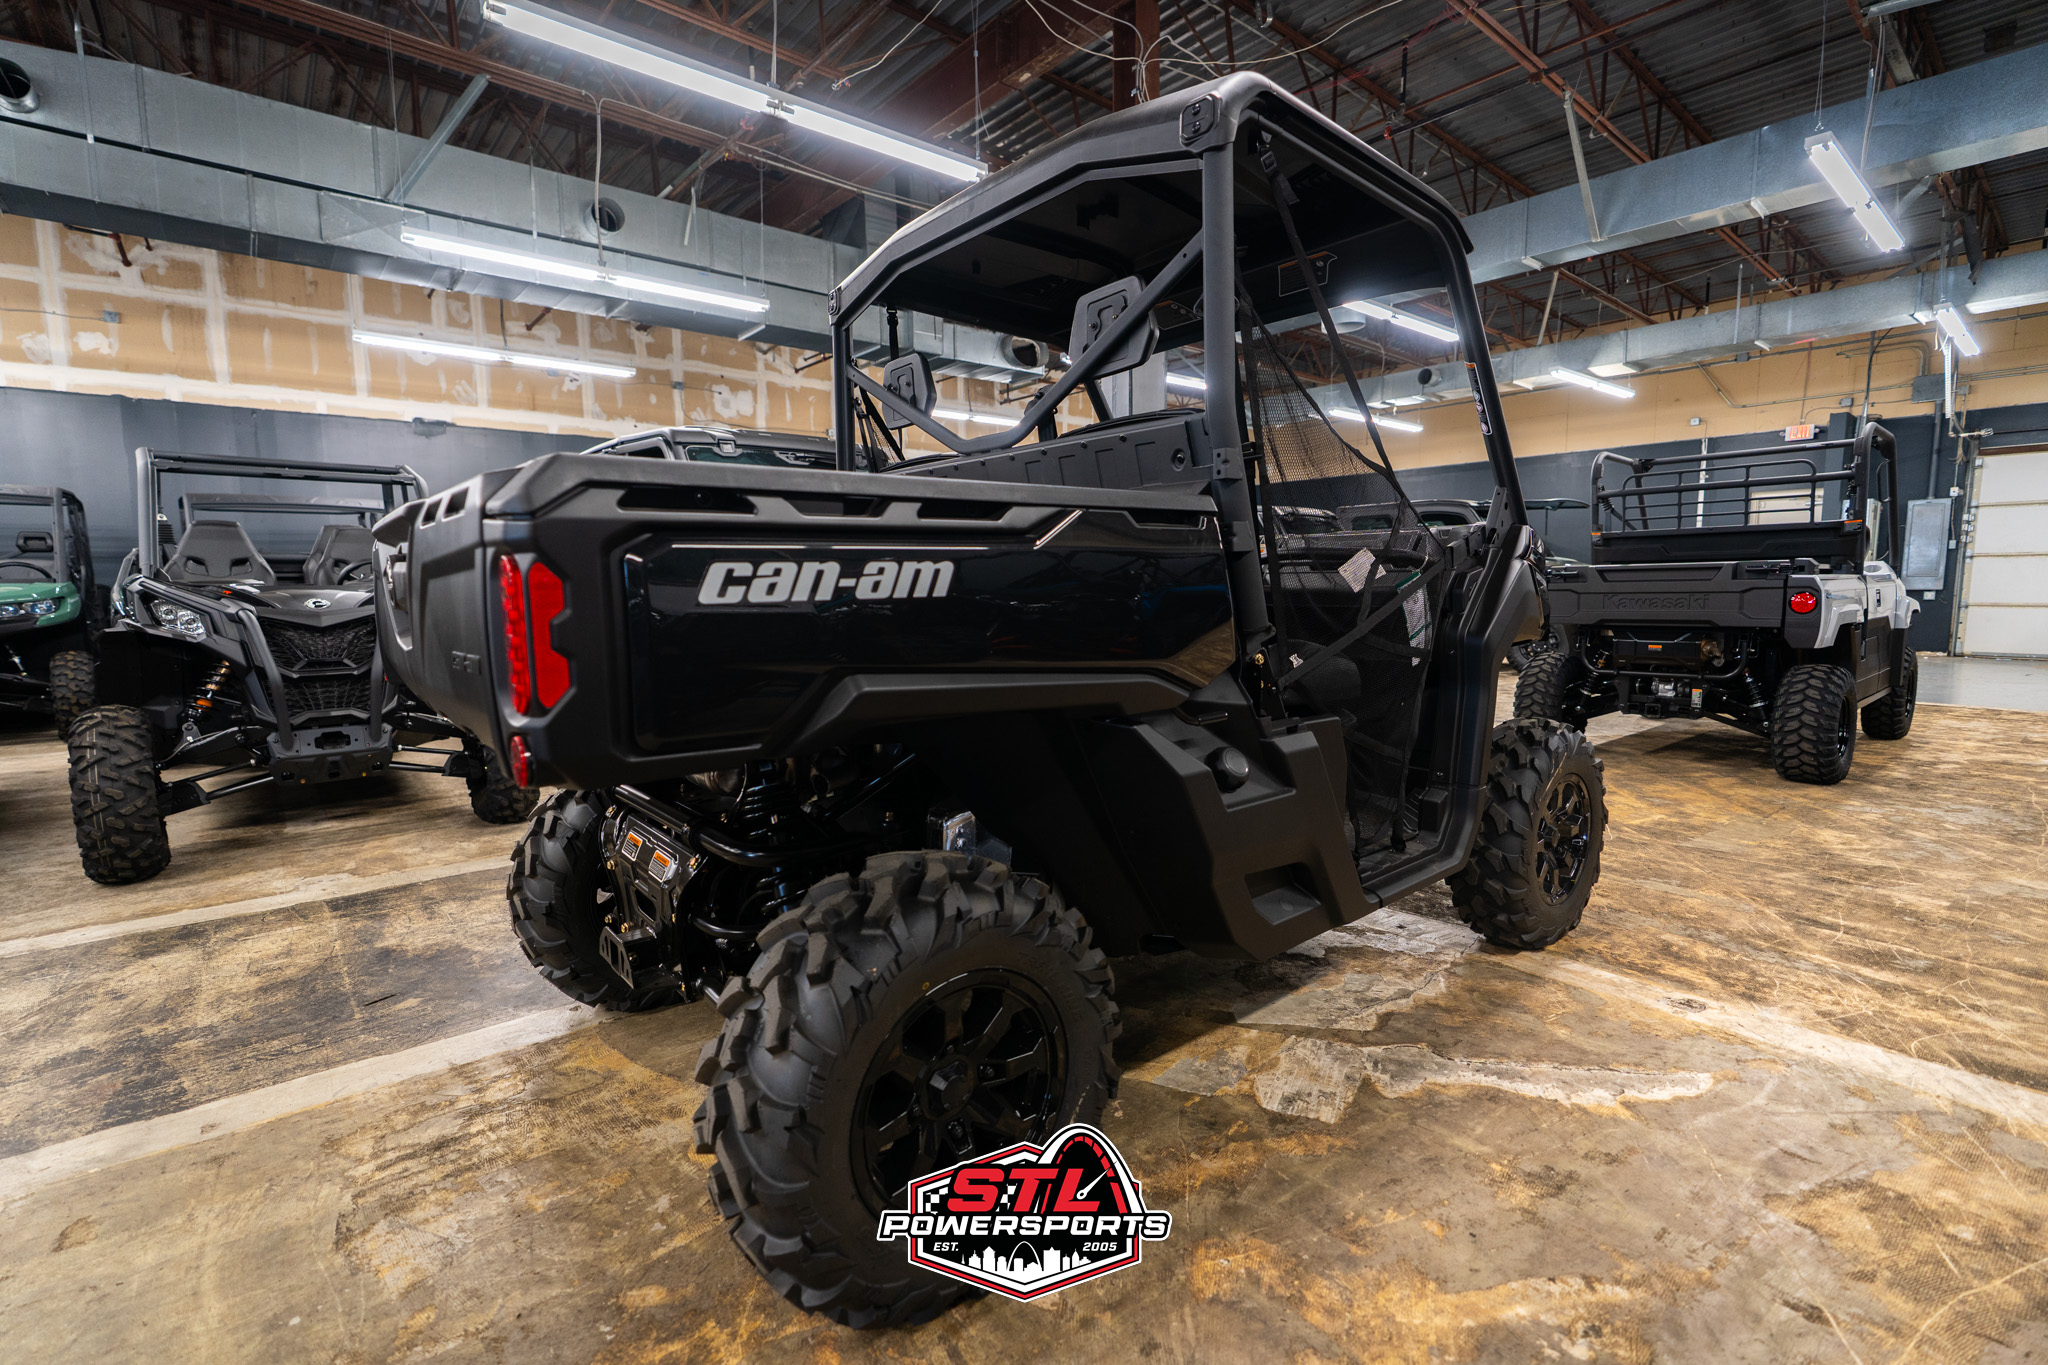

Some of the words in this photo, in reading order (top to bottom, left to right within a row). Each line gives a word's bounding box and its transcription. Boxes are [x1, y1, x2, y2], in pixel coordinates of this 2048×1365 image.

[1789, 425, 1811, 440] EXIT
[698, 560, 955, 605] can-am
[1602, 593, 1711, 610] Kawasaki
